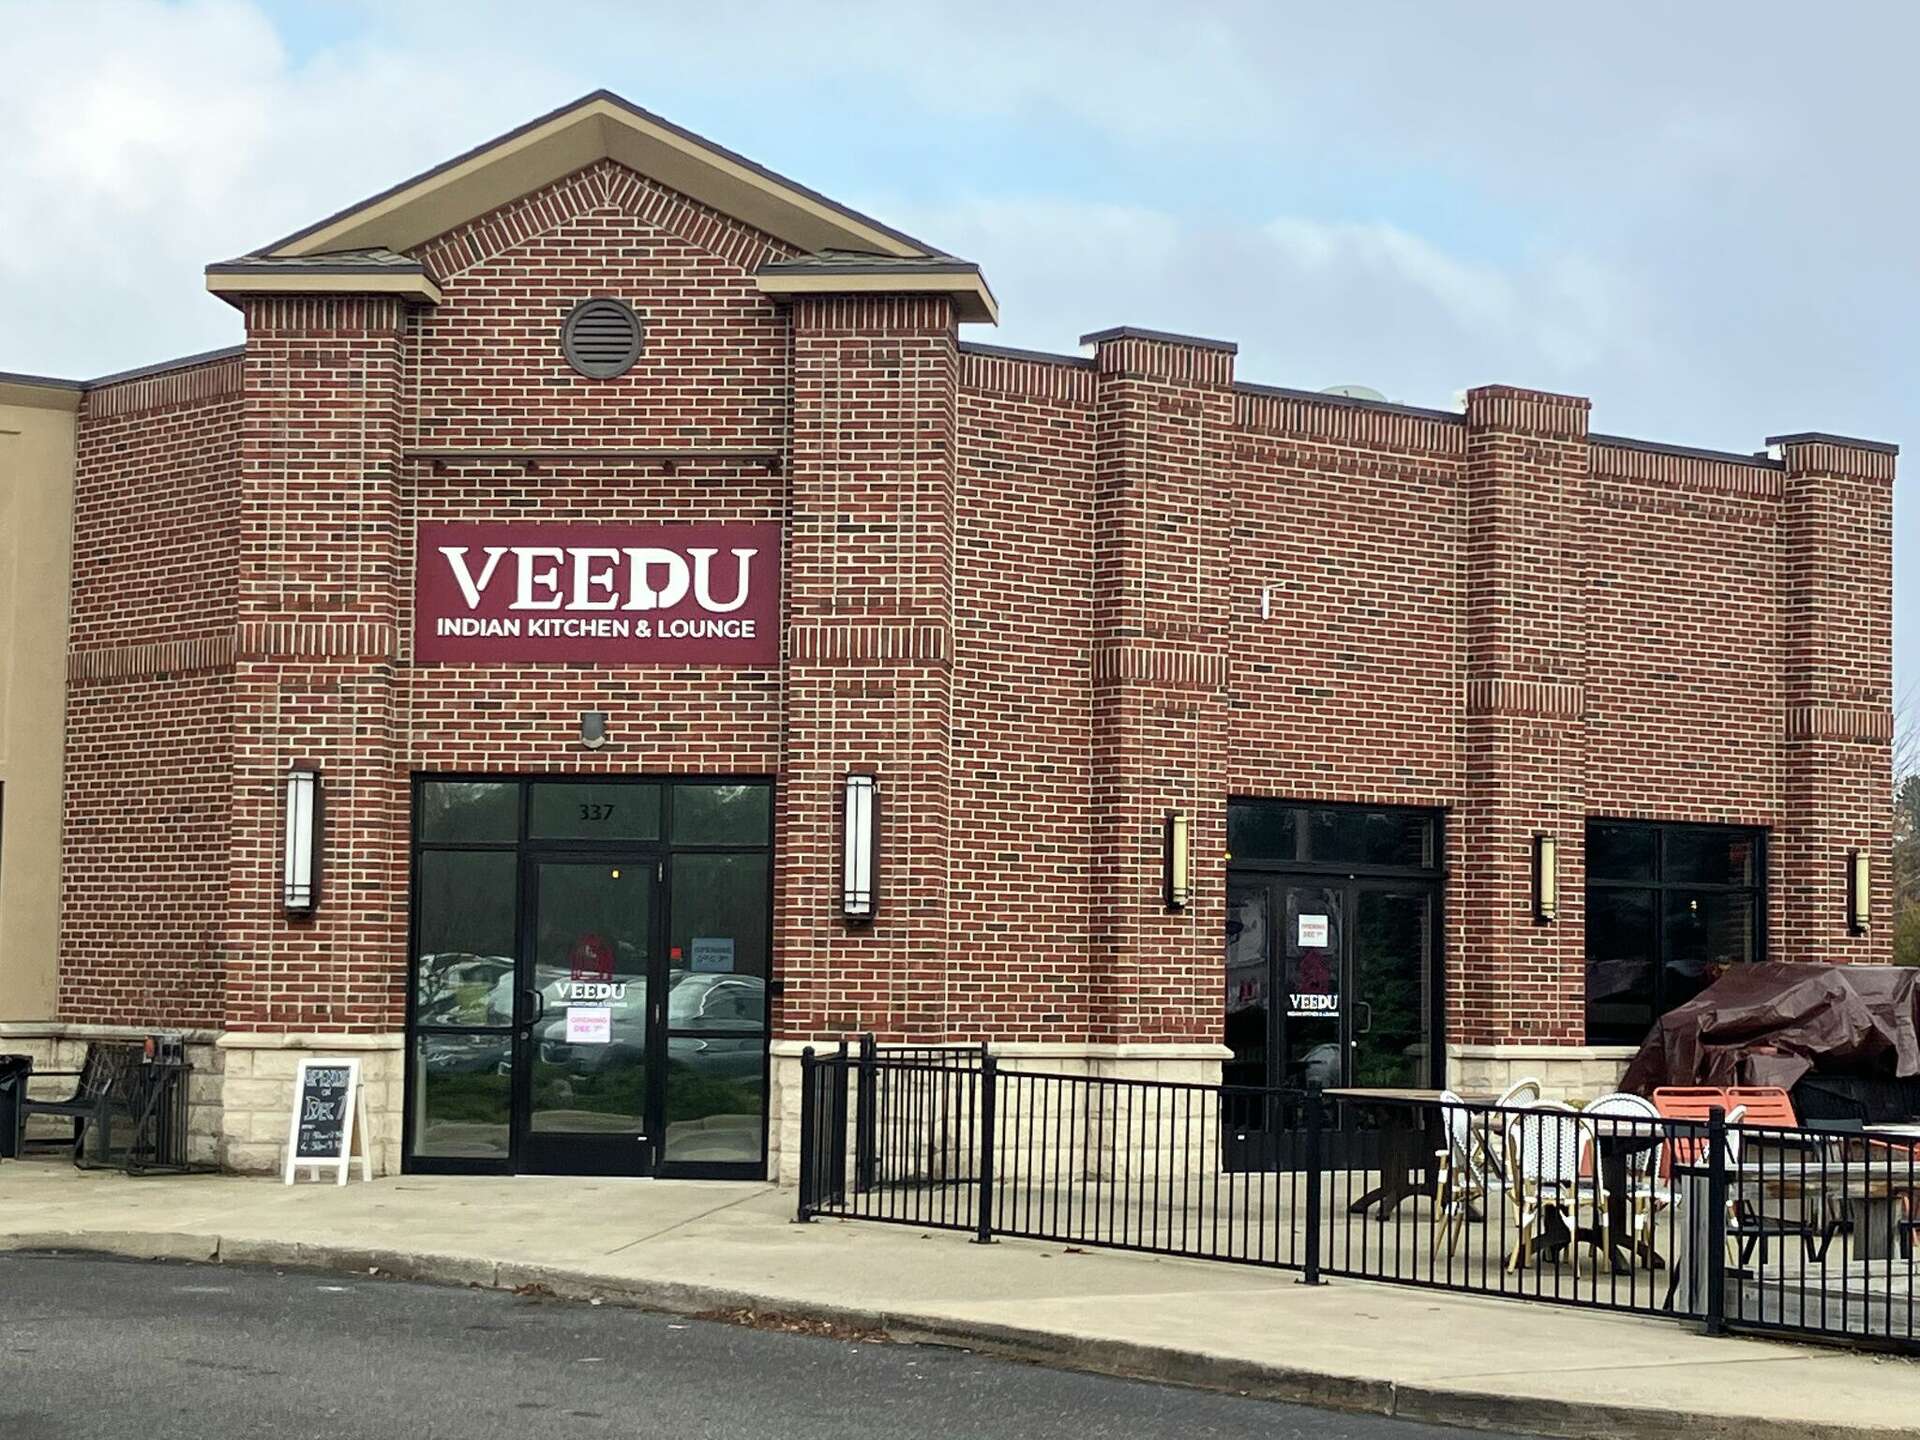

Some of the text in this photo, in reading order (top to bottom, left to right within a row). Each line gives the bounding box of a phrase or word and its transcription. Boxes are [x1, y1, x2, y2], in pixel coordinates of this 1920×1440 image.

[438, 546, 759, 613] VEEDU
[437, 618, 756, 639] INDIAN KITCHEN & LOUNGE
[579, 804, 615, 820] 337
[554, 983, 627, 1000] VEEDU
[1289, 994, 1338, 1010] VEEDU
